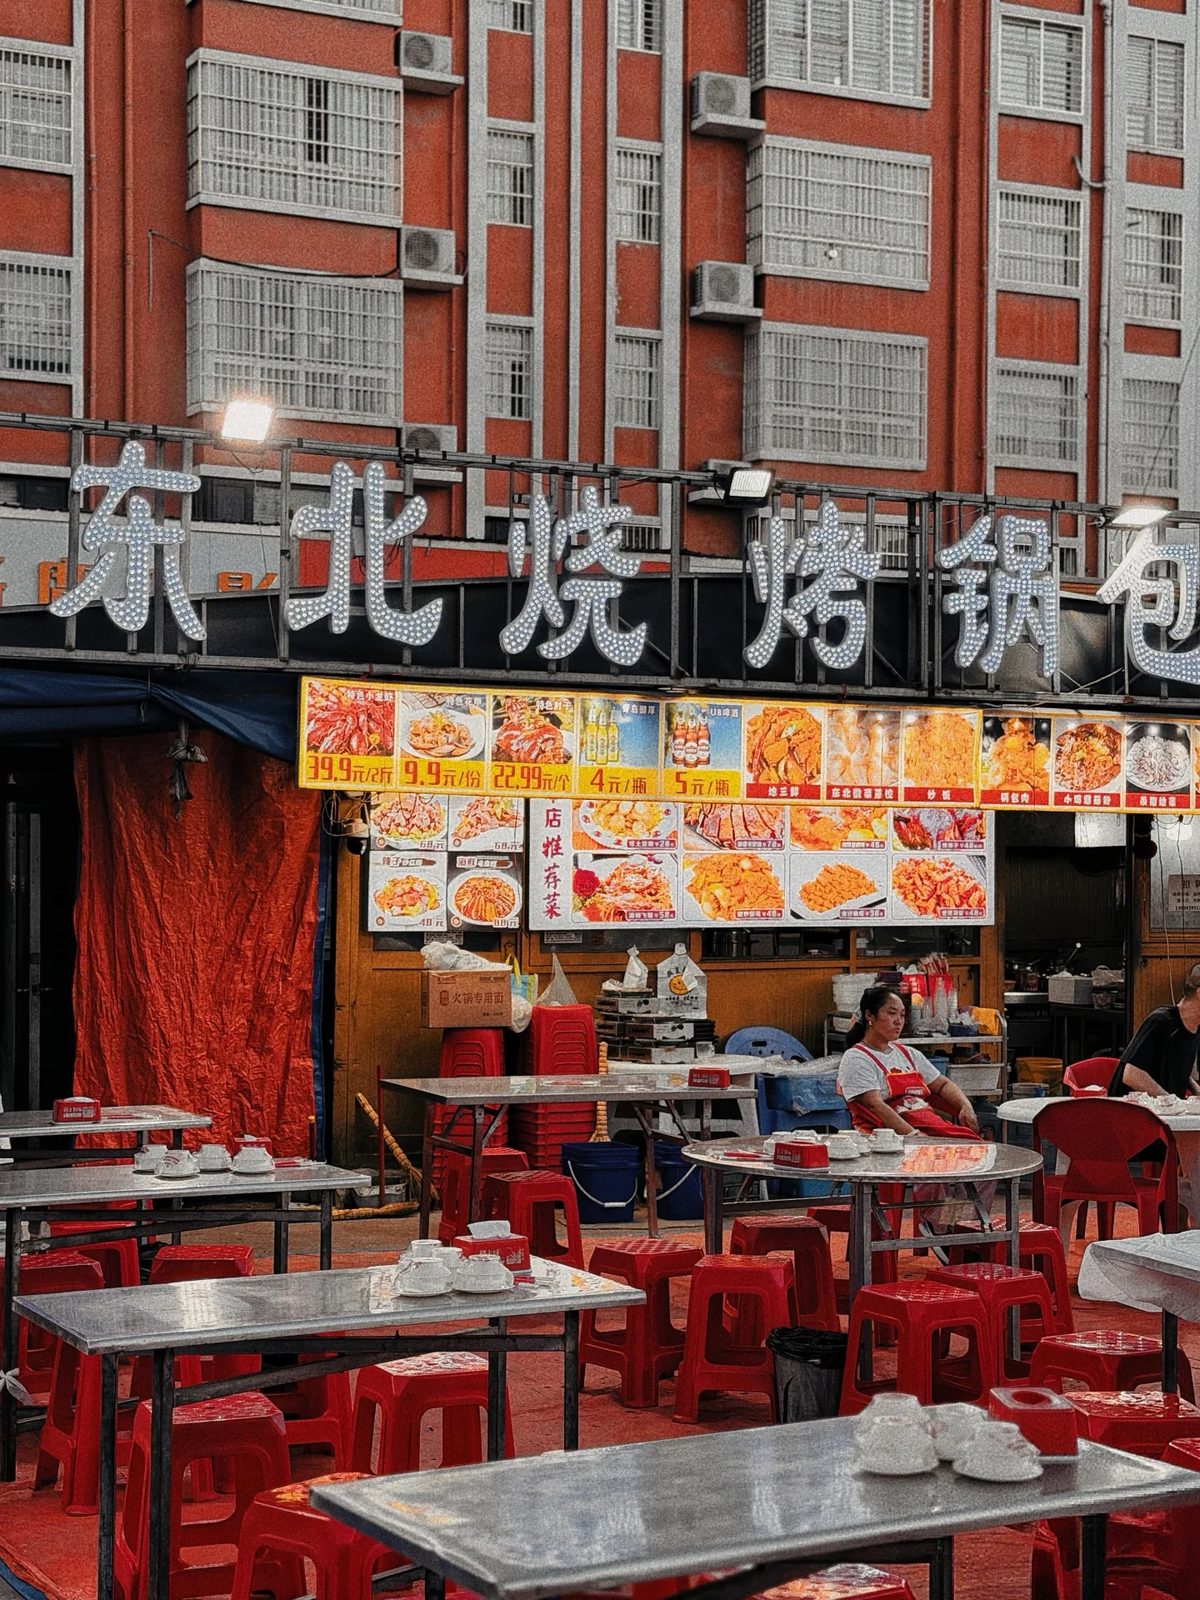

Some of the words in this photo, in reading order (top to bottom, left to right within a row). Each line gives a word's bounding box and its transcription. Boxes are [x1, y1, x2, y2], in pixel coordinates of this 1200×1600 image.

[494, 765, 570, 791] 22.99元/个
[590, 768, 647, 794] 4元/瓶
[675, 772, 729, 796] 5元/瓶
[1000, 792, 1029, 804] 锅包肉
[542, 799, 564, 920] 店推荐菜
[451, 992, 504, 1005] 火锅专用面
